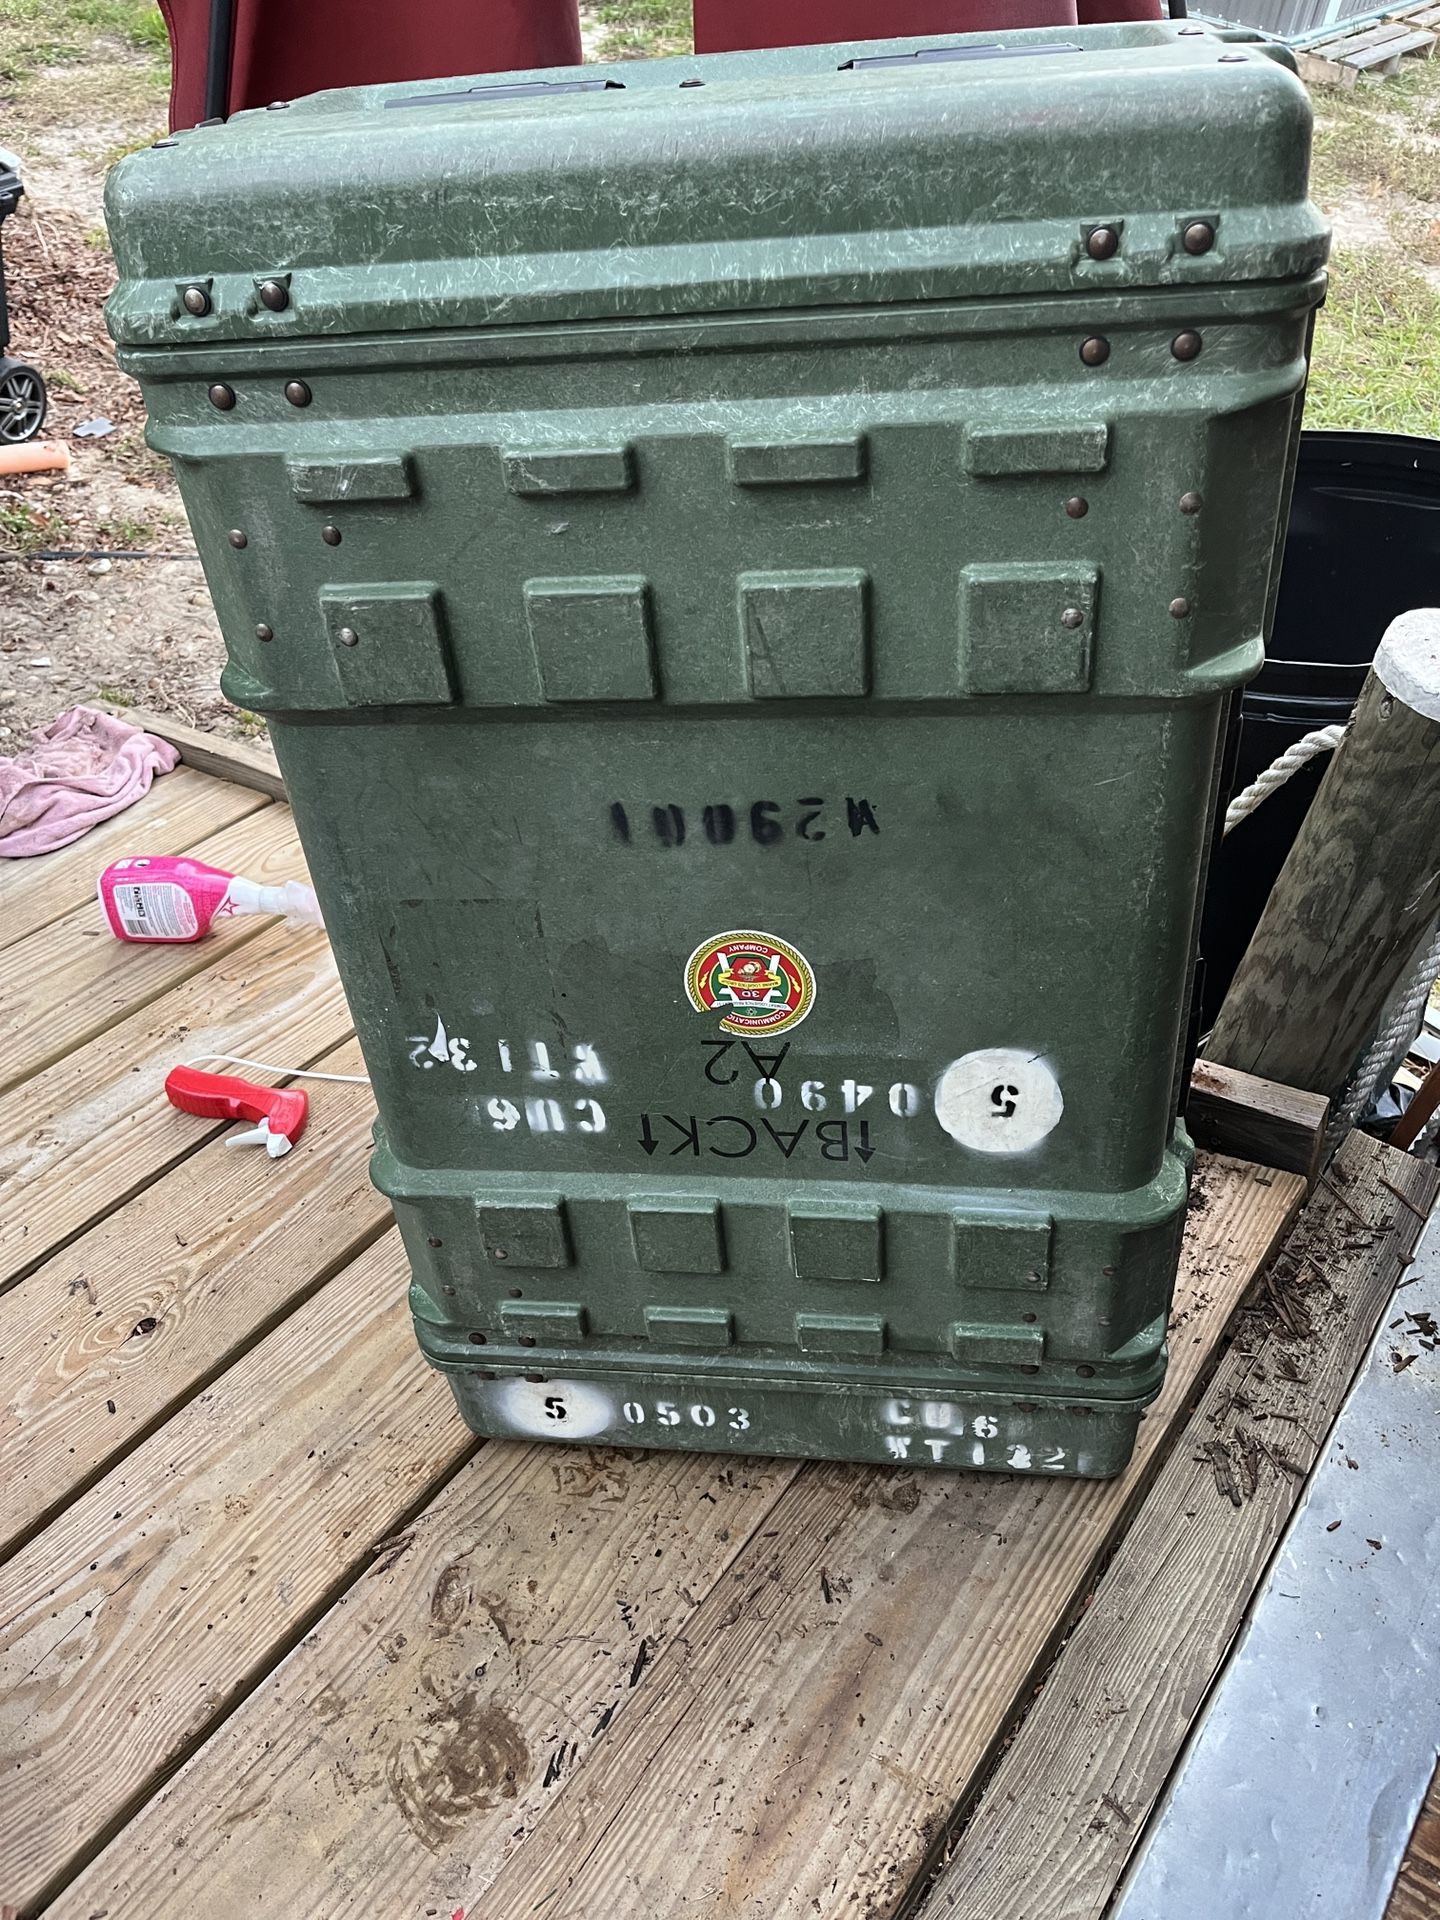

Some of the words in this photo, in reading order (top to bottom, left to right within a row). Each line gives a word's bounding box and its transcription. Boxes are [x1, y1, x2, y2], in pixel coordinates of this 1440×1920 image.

[729, 944, 768, 954] COMPANY
[741, 990, 760, 998] 3D
[701, 1040, 791, 1085] A2
[754, 1077, 920, 1117] 0490
[990, 1084, 1019, 1118] 5
[662, 1115, 849, 1161] BACK
[544, 1397, 567, 1419] 5
[623, 1401, 750, 1430] 0503
